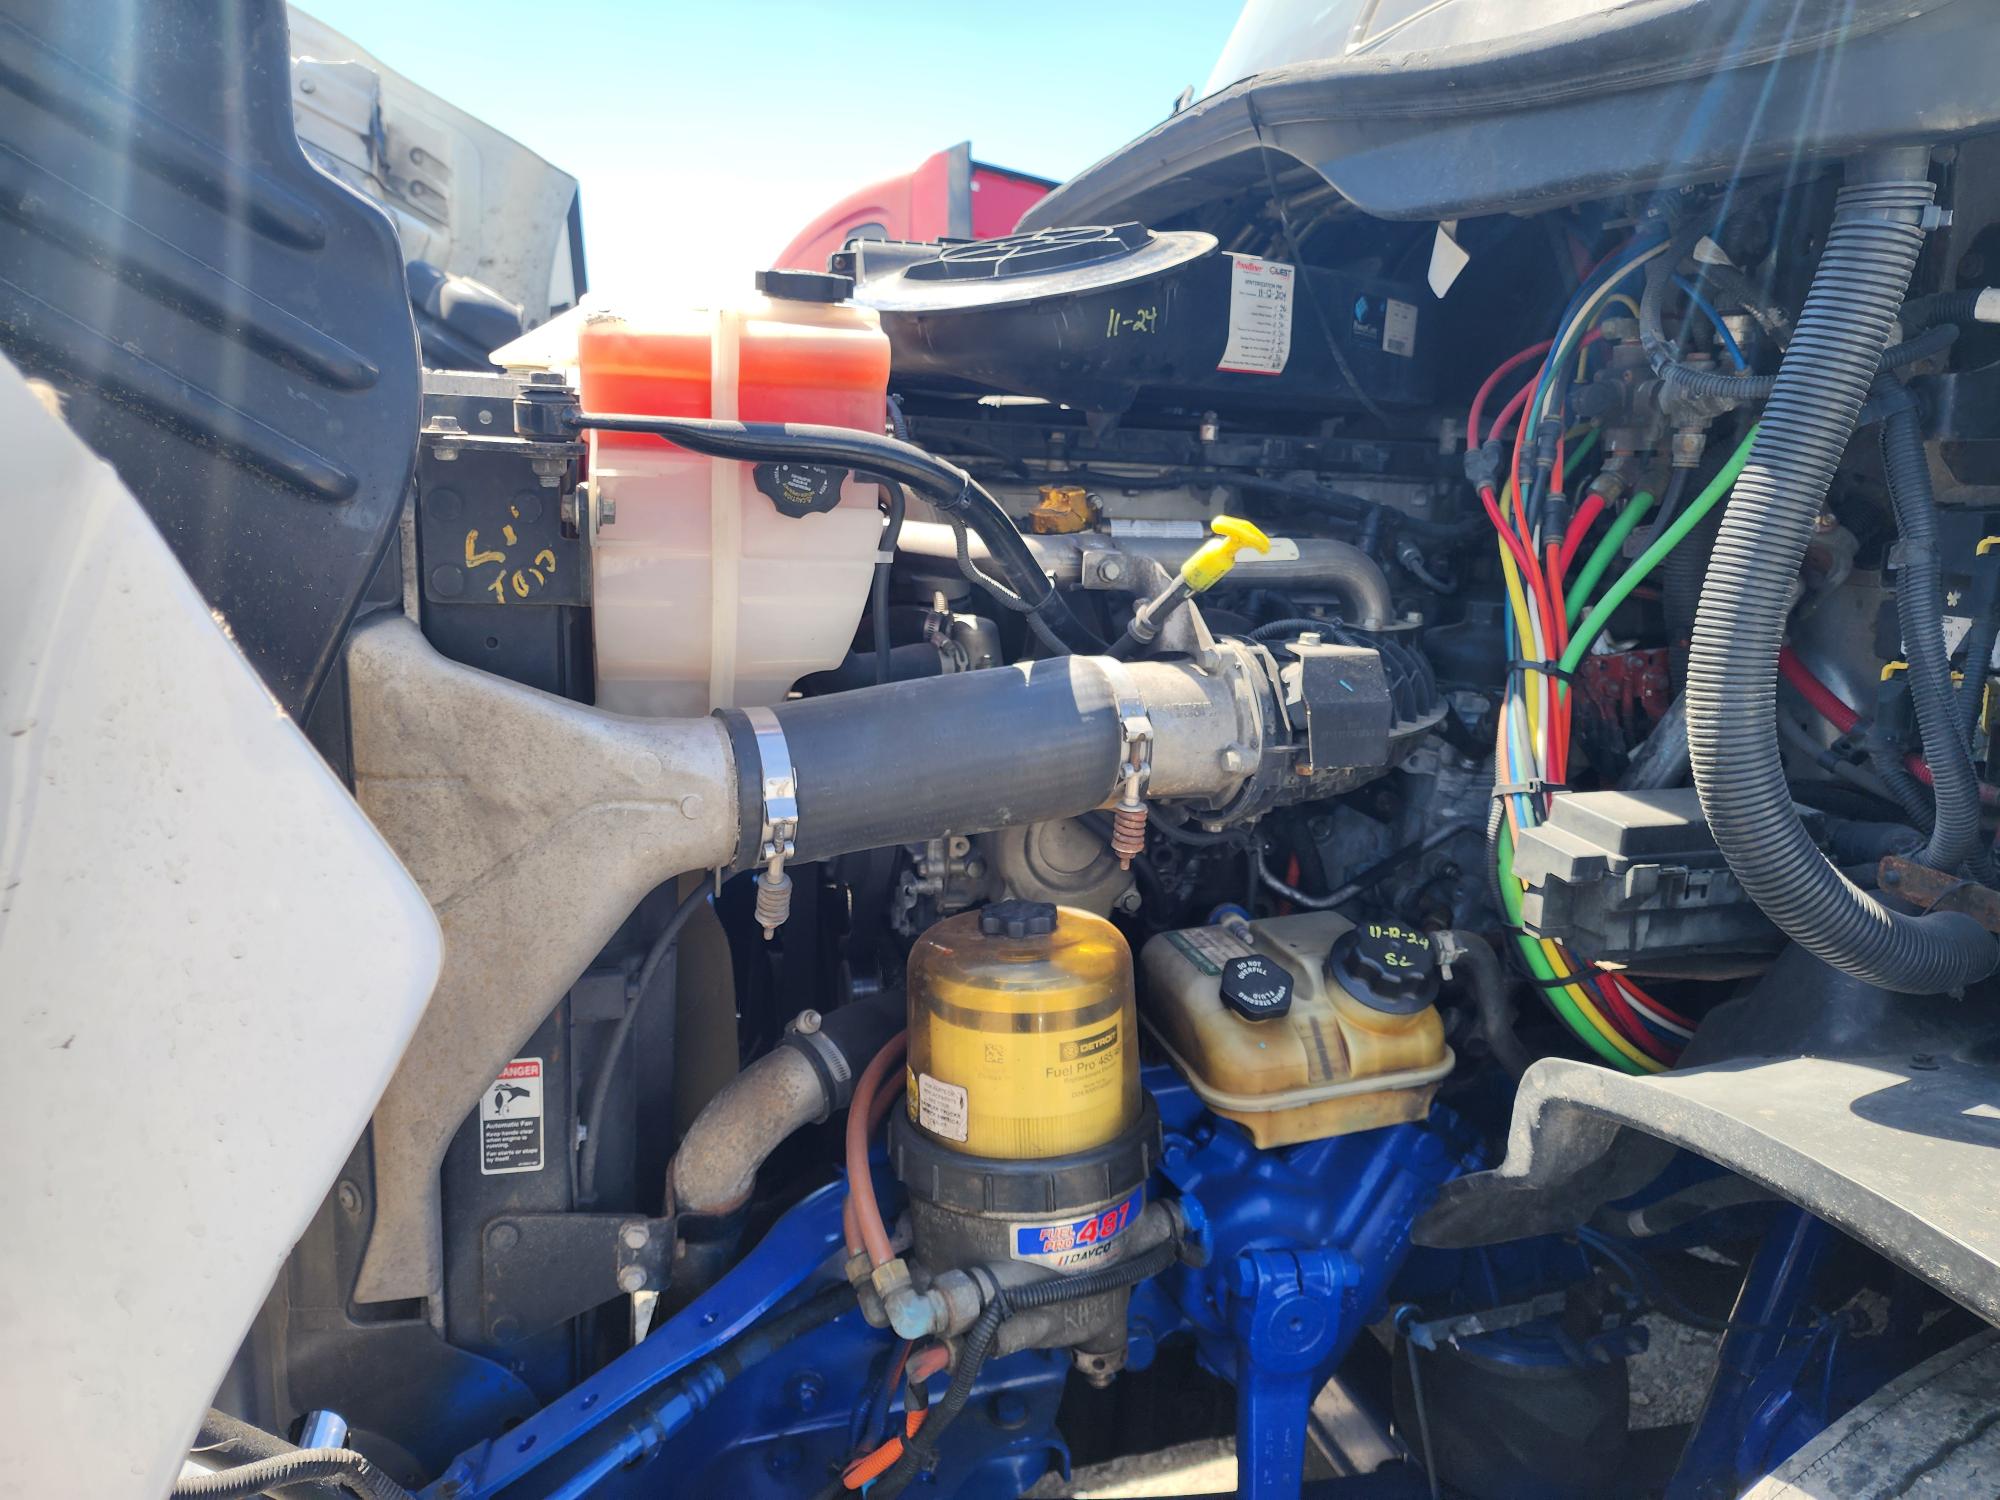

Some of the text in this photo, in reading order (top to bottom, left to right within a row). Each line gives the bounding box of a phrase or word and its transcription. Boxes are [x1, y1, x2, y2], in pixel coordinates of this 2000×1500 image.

[1107, 306, 1157, 338] 11-24
[1237, 962, 1247, 970] DO
[1237, 966, 1267, 980] OVERFILL
[1238, 985, 1286, 1006] POWER STEERING
[1252, 990, 1275, 1000] FLUID
[1080, 1031, 1117, 1053] DETROIT
[500, 1065, 538, 1077] ANGER
[1046, 1065, 1073, 1079] Fuel
[1039, 1225, 1075, 1241] FUEL
[1043, 1239, 1074, 1253] PRO
[1070, 1243, 1111, 1264] DAVCO
